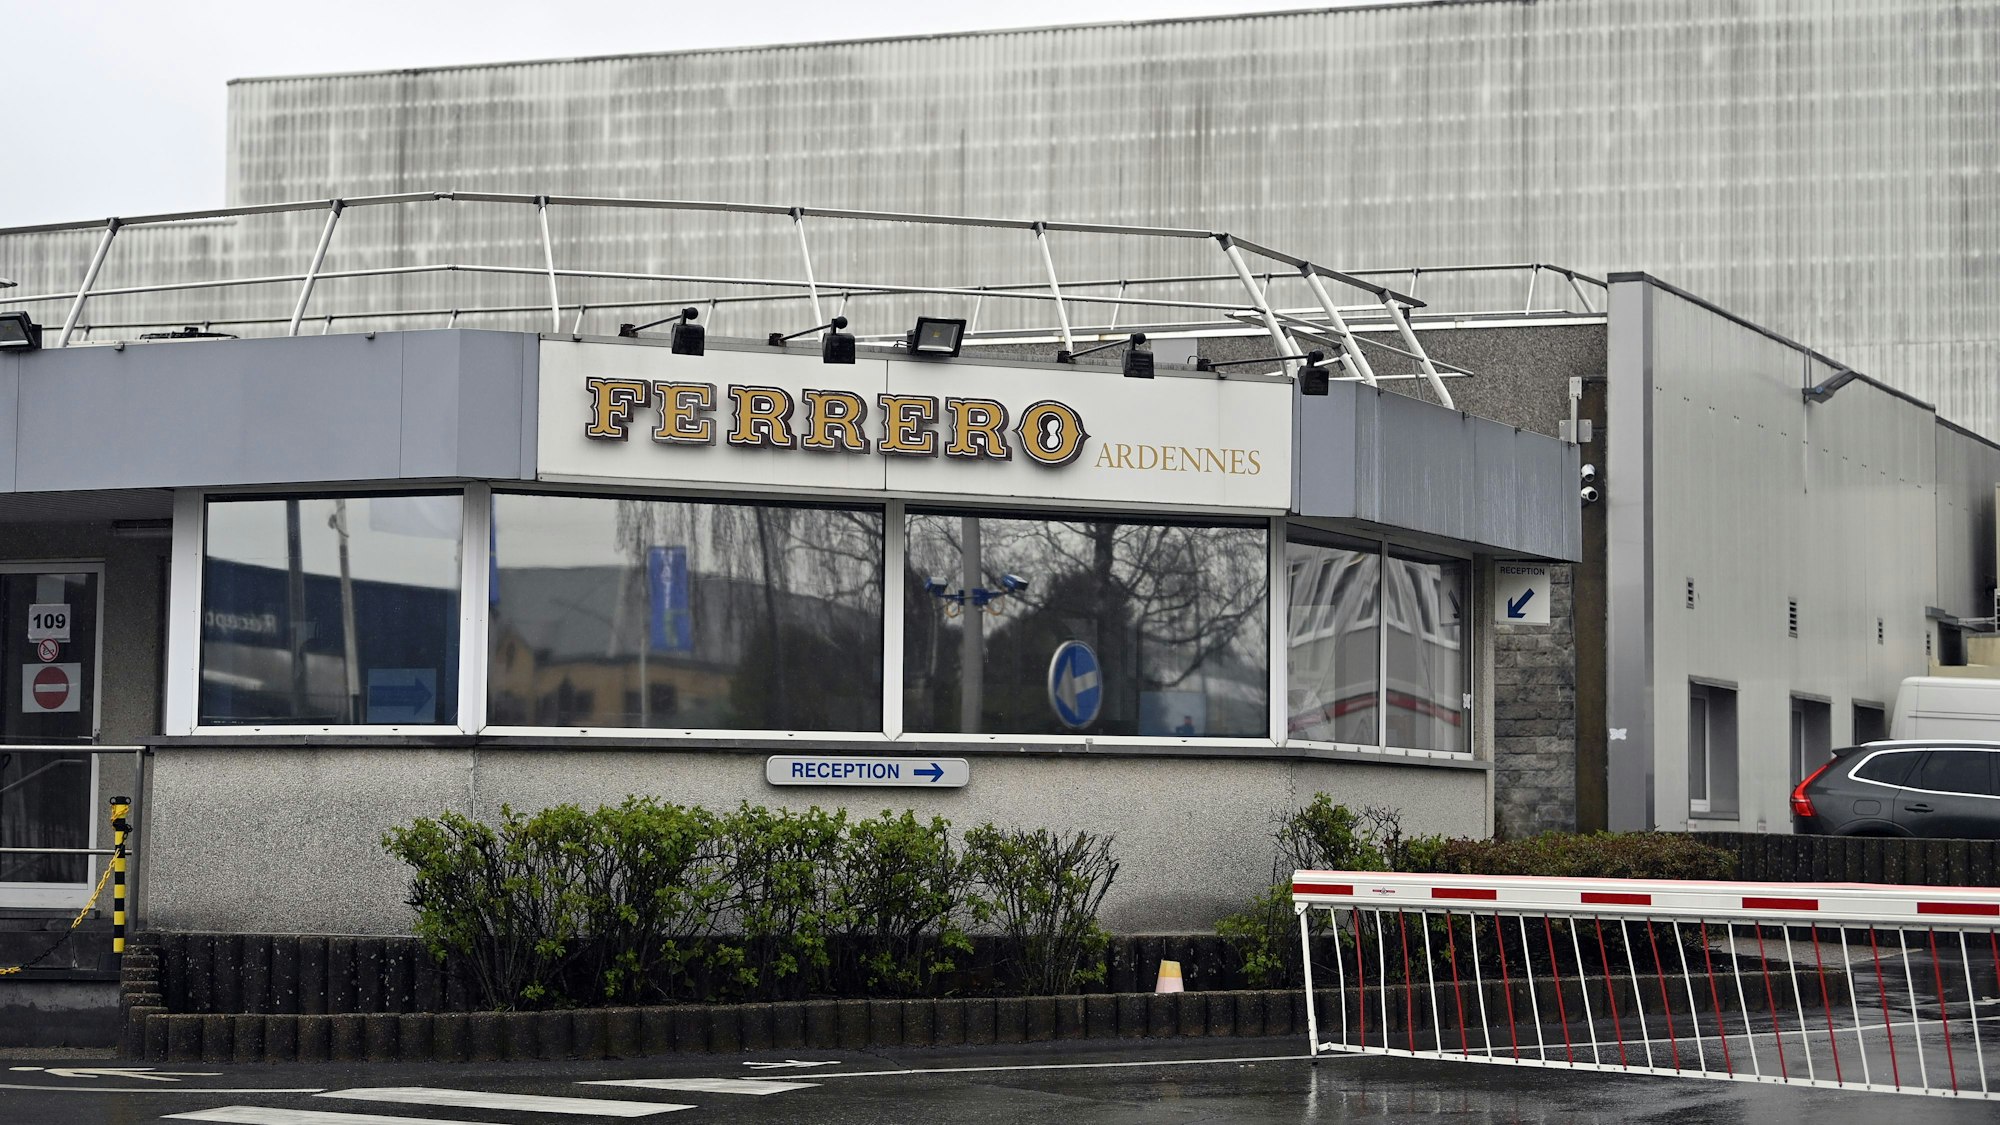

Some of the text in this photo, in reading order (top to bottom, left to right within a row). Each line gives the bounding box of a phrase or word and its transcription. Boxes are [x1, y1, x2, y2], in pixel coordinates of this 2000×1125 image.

[585, 375, 1261, 475] FERRERO ARDENNES
[1500, 566, 1545, 576] RECEPTION
[33, 613, 66, 629] 109
[791, 762, 900, 779] RECEPTION
